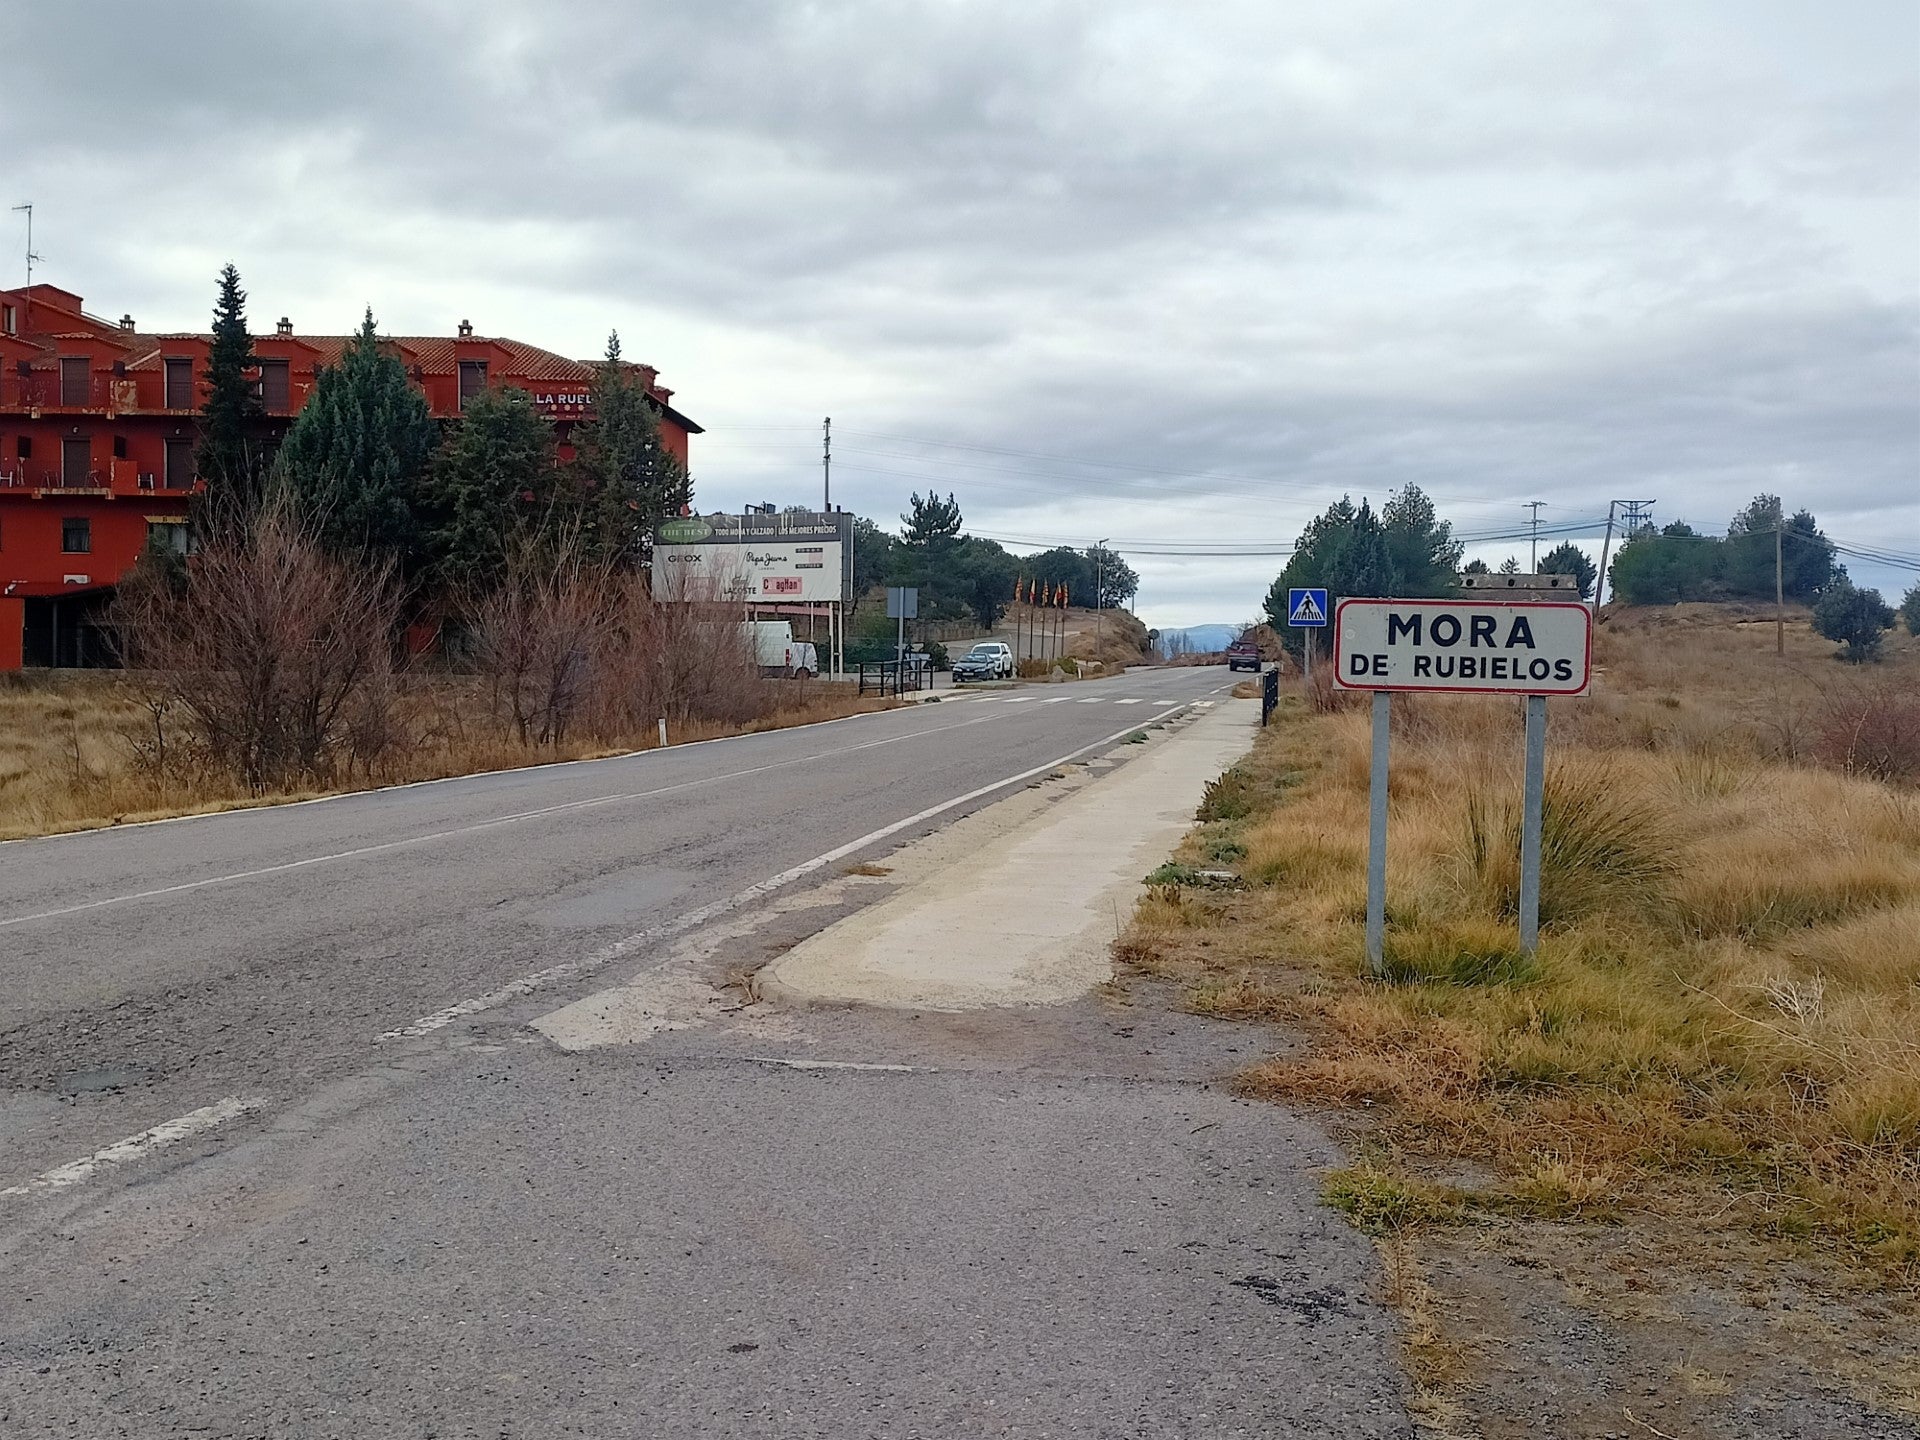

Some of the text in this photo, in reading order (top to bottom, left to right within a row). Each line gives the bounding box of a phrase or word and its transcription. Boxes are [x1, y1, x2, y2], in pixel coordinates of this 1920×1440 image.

[536, 394, 554, 404] LA
[715, 528, 729, 536] TODO
[750, 527, 774, 536] CALZADO
[789, 525, 813, 535] MEJORES
[814, 525, 837, 534] PRECIOS
[1387, 613, 1536, 649] MORA
[1350, 654, 1573, 681] DE RUBIELOS
